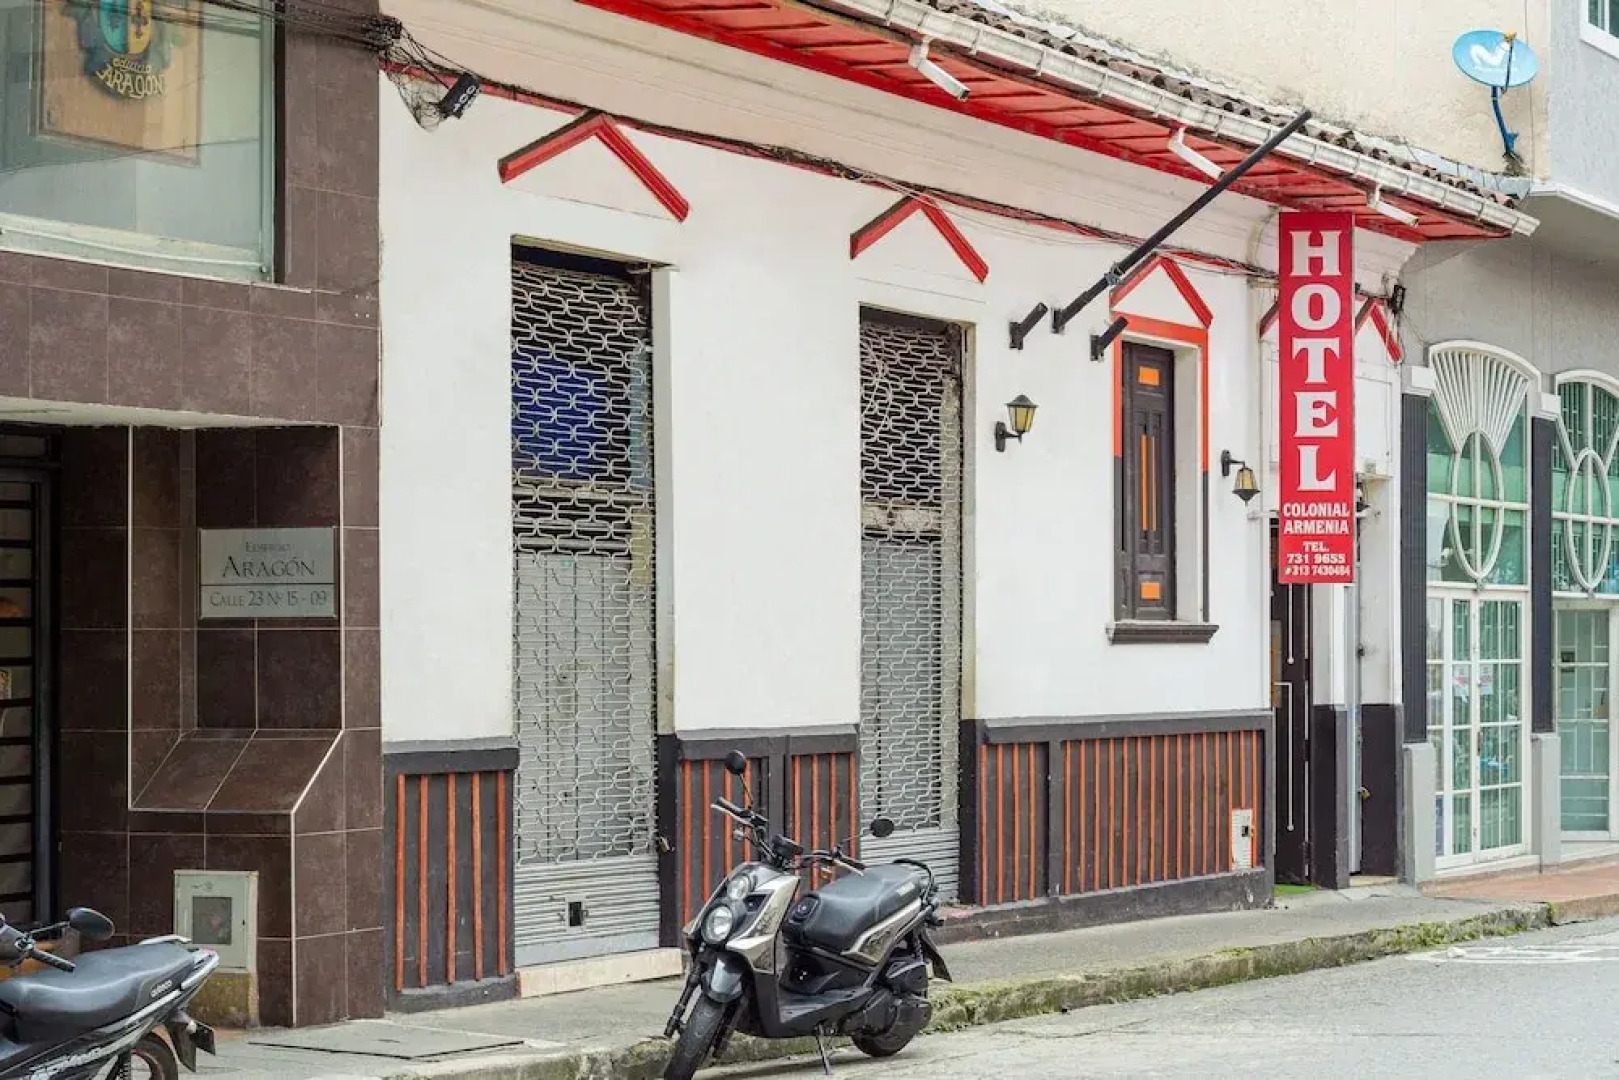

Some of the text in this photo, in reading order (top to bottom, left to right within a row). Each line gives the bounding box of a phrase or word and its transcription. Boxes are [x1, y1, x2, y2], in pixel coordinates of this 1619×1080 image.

[1288, 230, 1342, 492] HOTEL
[1283, 502, 1350, 517] COLONIAL
[1283, 519, 1350, 534] ARMENIA
[1302, 541, 1330, 552] TEL.
[222, 555, 315, 577] ARAGÓN
[1286, 553, 1346, 564] 731 9655
[210, 592, 244, 606] CALLE
[248, 590, 264, 606] 23
[287, 590, 299, 606] 15
[310, 590, 328, 606] 09
